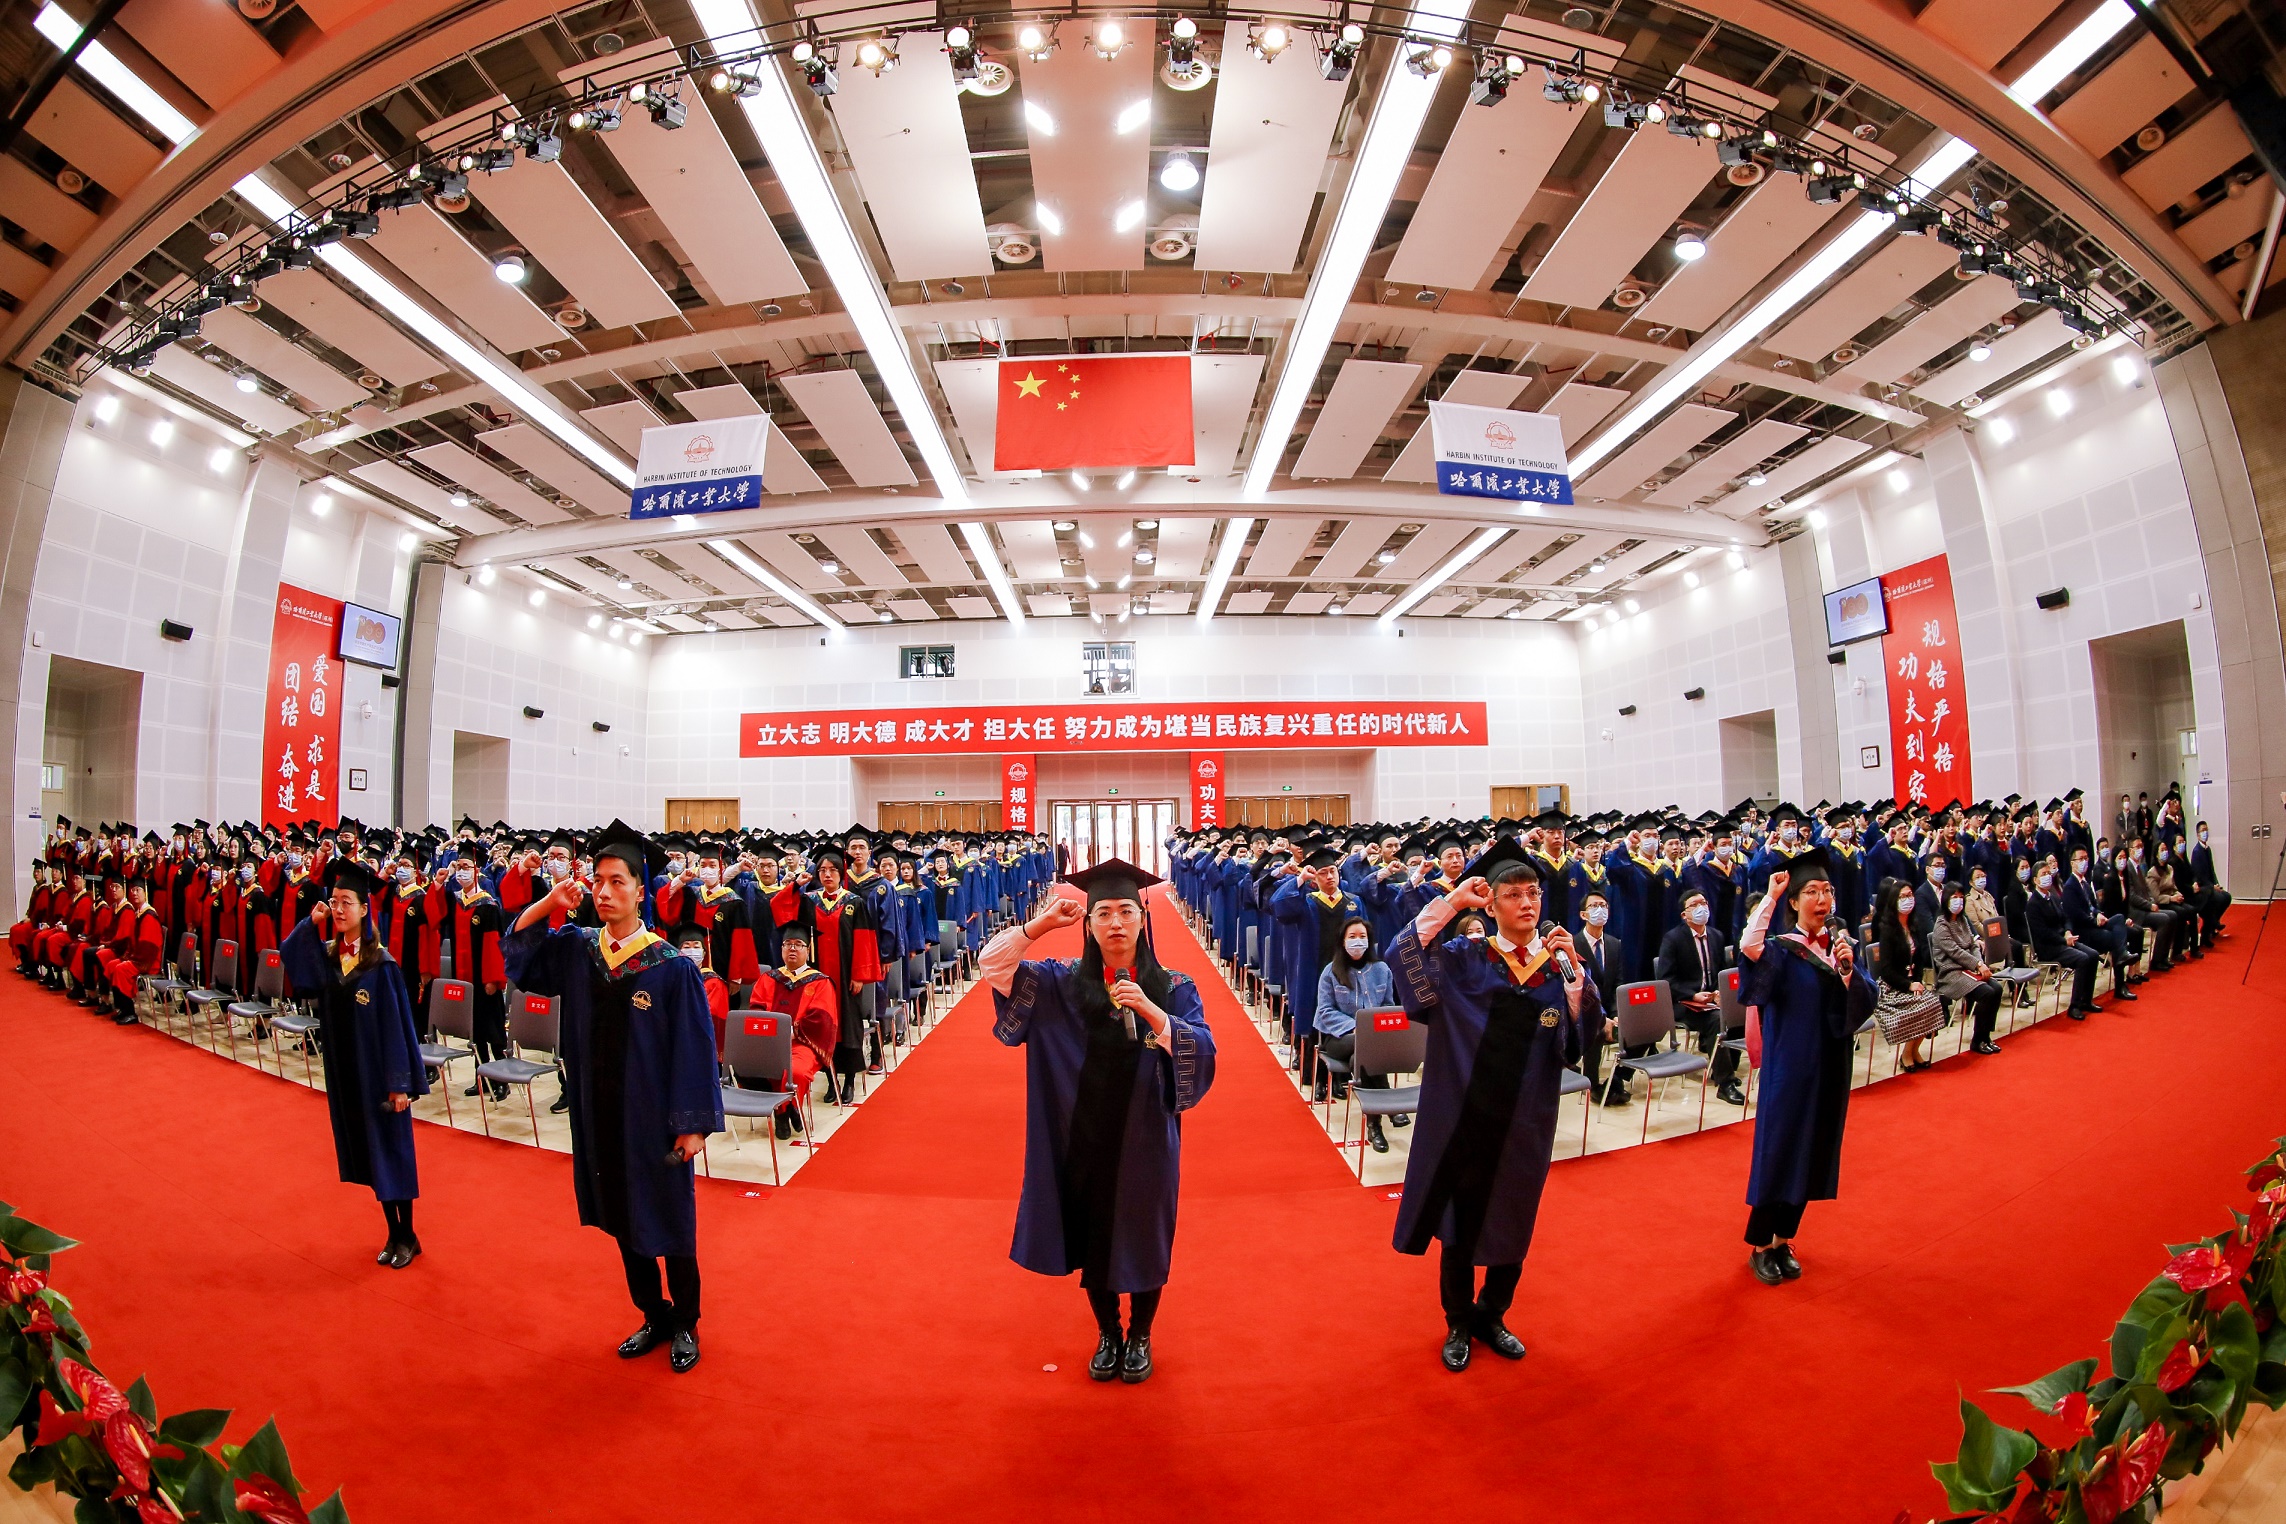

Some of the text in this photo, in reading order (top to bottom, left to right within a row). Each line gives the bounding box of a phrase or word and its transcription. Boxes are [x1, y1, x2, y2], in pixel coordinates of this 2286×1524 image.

[643, 464, 753, 483] HARBIN INSTITUTE OF TECHNOLOGY
[1446, 451, 1558, 470] HARBIN INSTITUTE OF TECHNOLOGY
[277, 662, 300, 813] 团结 奋进
[305, 653, 329, 801] 爱国 求是
[757, 712, 1470, 746] 立大志 明大德 成大才 担大任 努力成为堪当民族复兴重任的时代新人
[1898, 652, 1928, 805] 功夫到家
[1922, 619, 1955, 773] 规格严格
